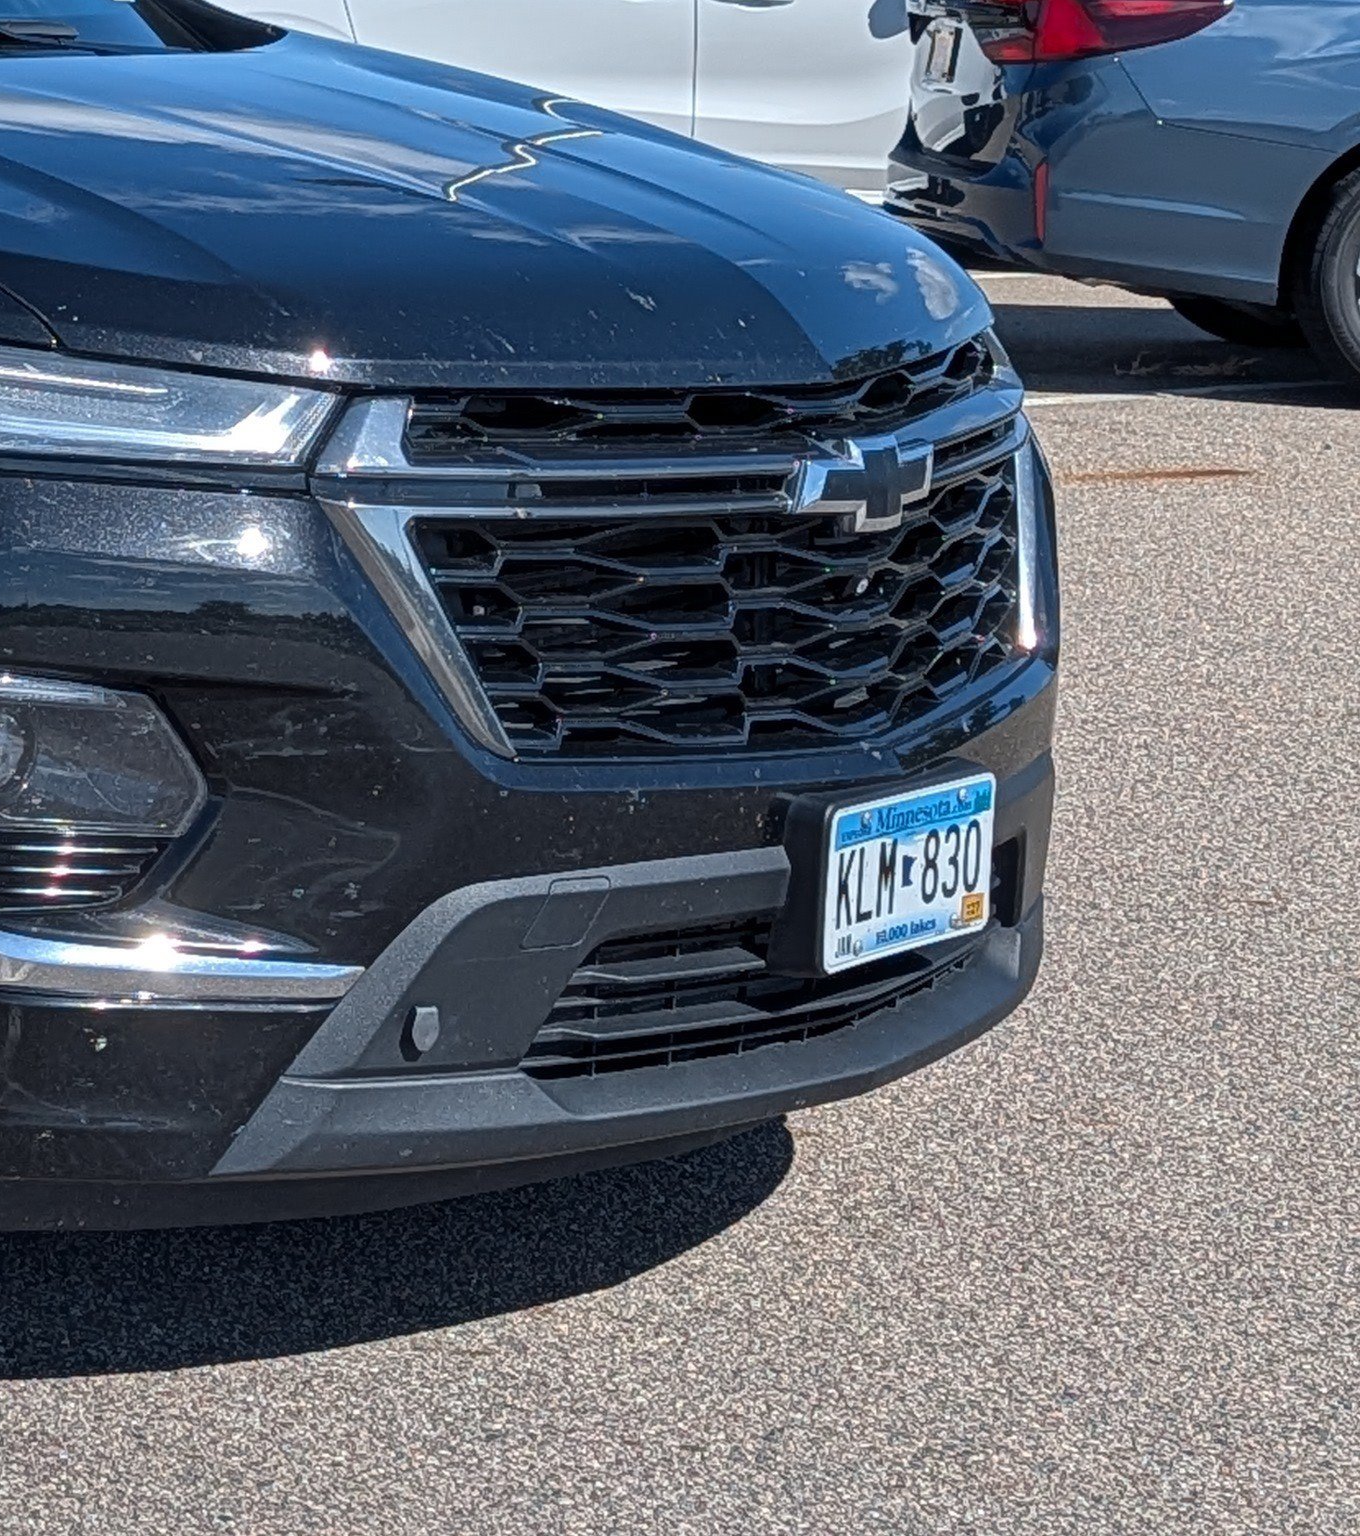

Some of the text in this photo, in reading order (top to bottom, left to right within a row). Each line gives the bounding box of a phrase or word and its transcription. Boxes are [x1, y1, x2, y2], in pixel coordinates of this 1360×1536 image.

[835, 819, 982, 930] KLM 830
[909, 917, 937, 937] lakes
